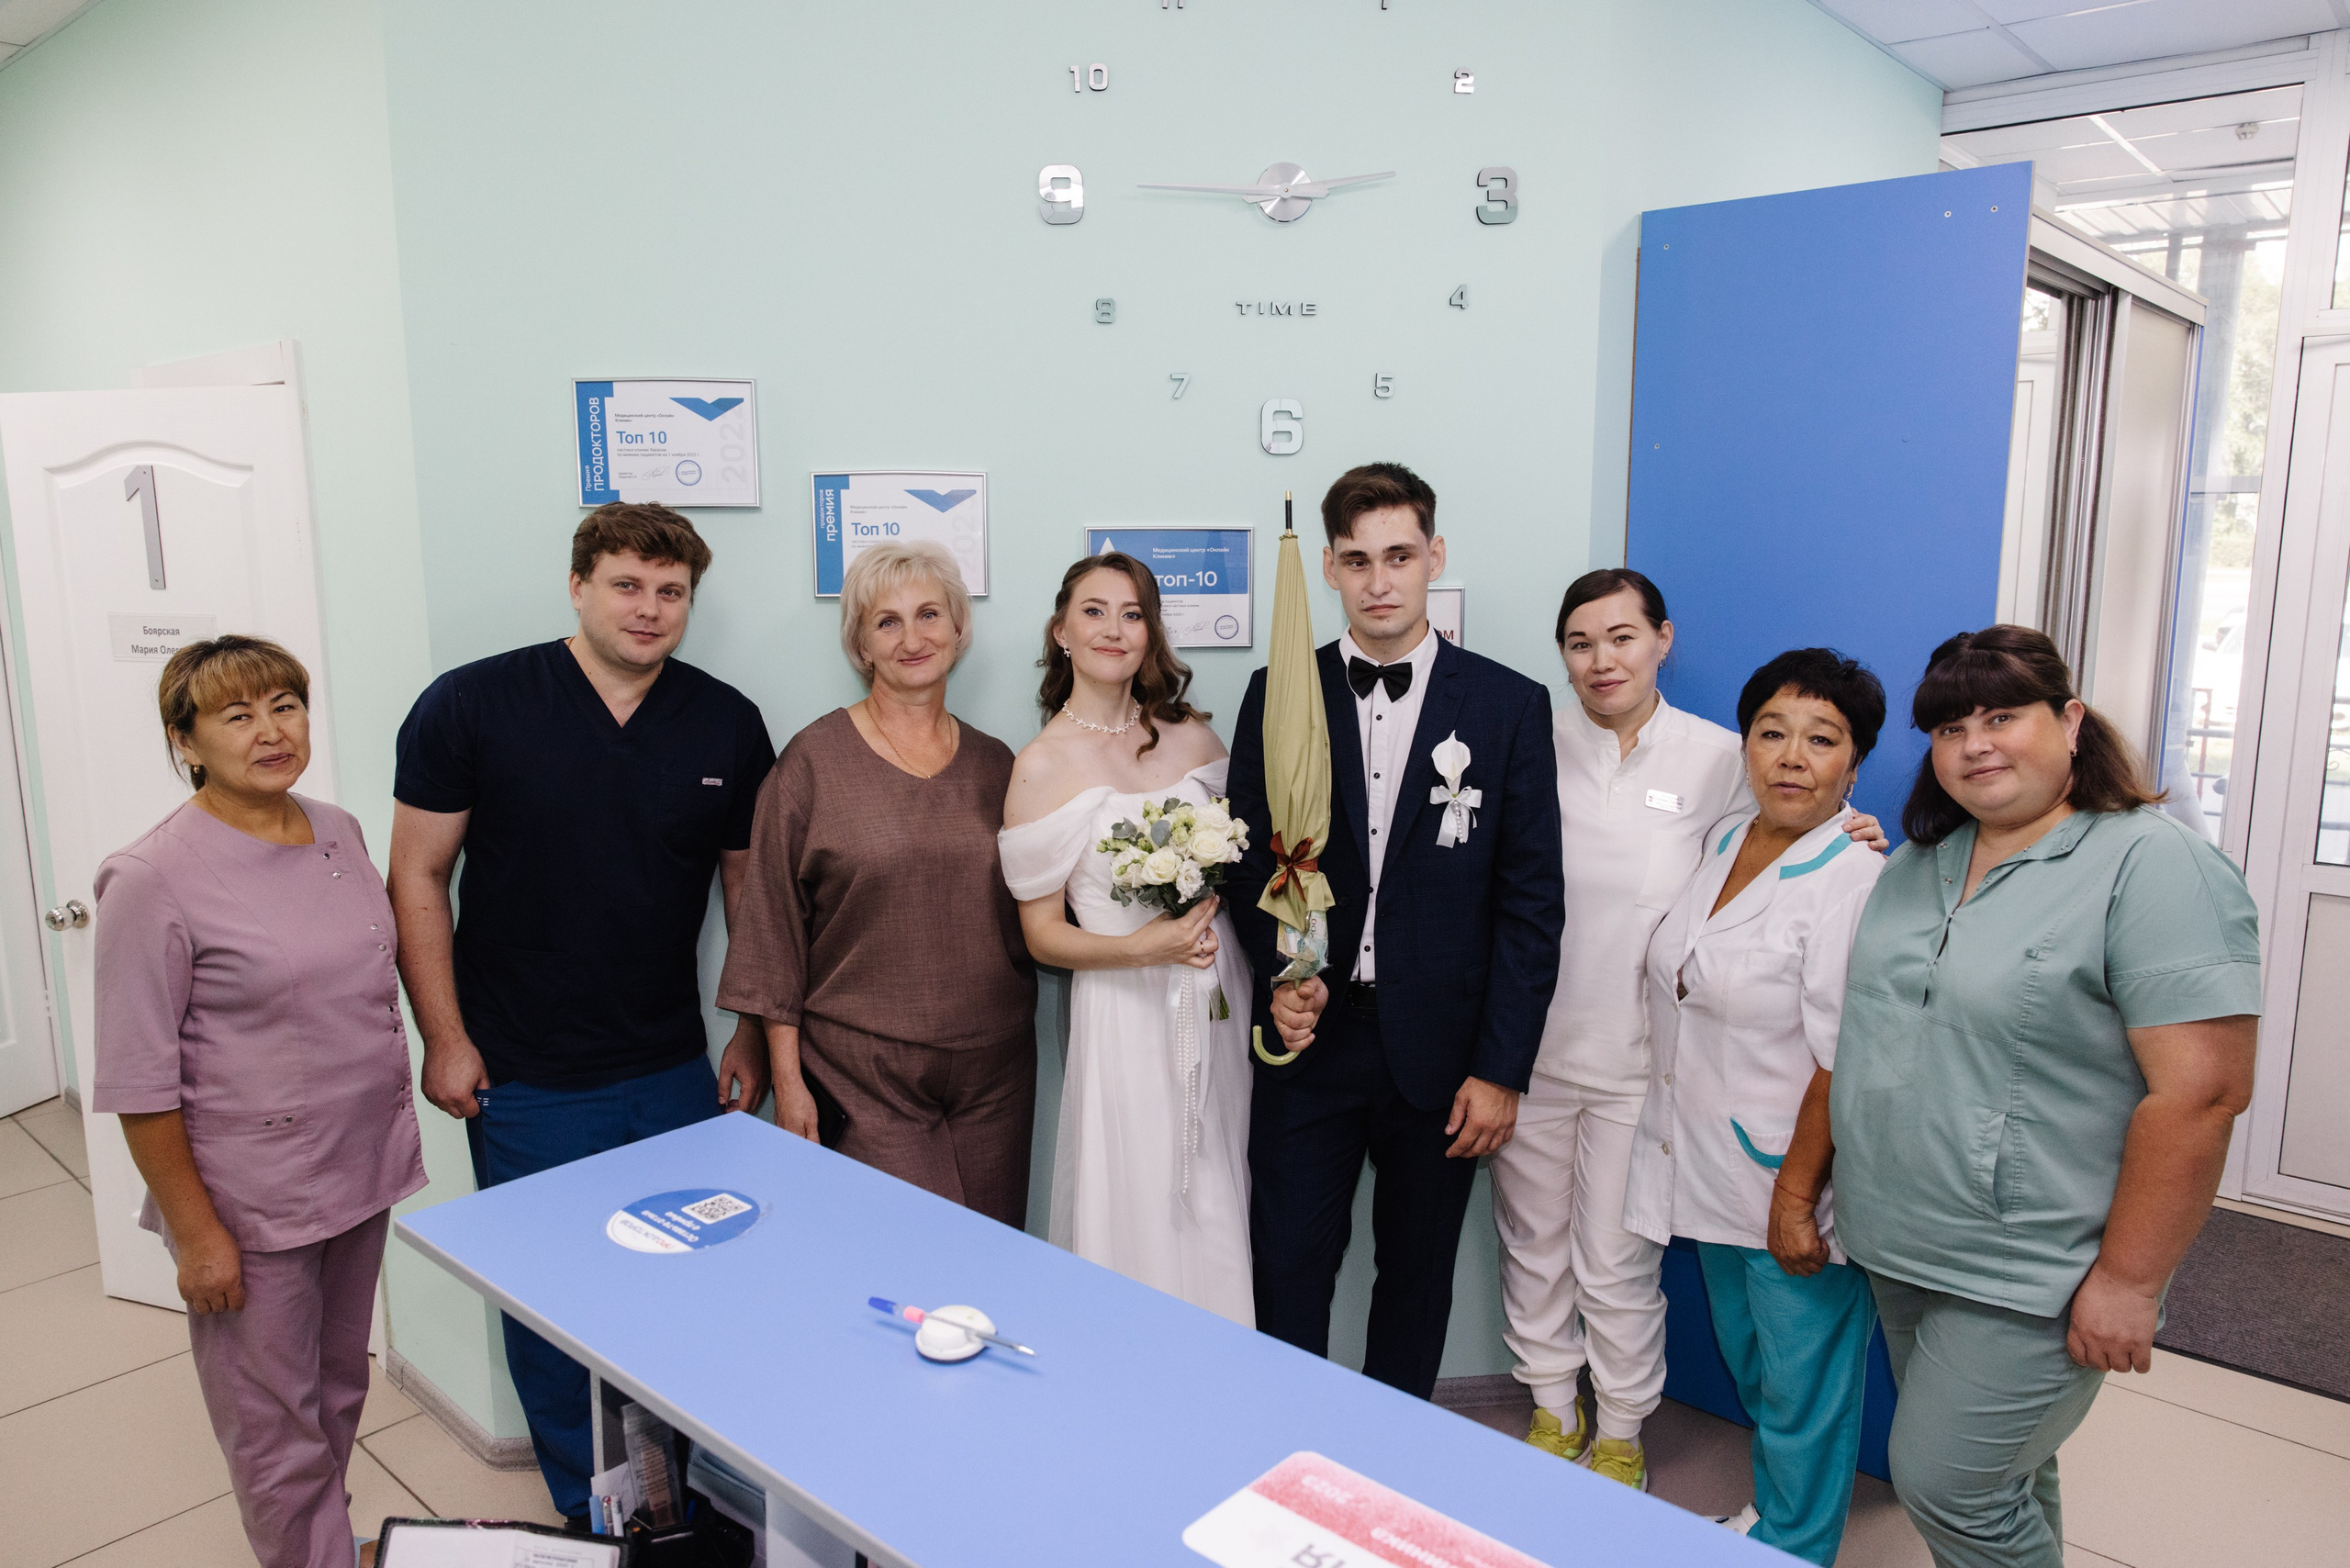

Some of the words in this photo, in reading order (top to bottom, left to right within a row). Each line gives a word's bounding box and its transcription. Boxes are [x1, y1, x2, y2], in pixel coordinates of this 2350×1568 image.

[1069, 62, 1109, 93] 10
[1453, 66, 1474, 94] 2
[1038, 164, 1084, 225] 9
[1475, 165, 1518, 225] 3
[1095, 297, 1116, 324] 8
[1236, 300, 1317, 316] TIME
[1449, 284, 1469, 310] 4
[1169, 372, 1192, 399] 7
[1373, 372, 1395, 398] 5
[616, 431, 643, 444] Топ
[649, 431, 667, 444] 10
[1260, 398, 1304, 455] 6
[588, 397, 605, 491] ПРОДОКТОРОВ
[124, 465, 166, 589] 1
[825, 489, 838, 542] премия
[851, 522, 879, 536] Топ
[883, 522, 900, 536] 10
[143, 625, 180, 637] Боярская
[131, 644, 158, 655] Мария
[160, 644, 180, 655] Олег
